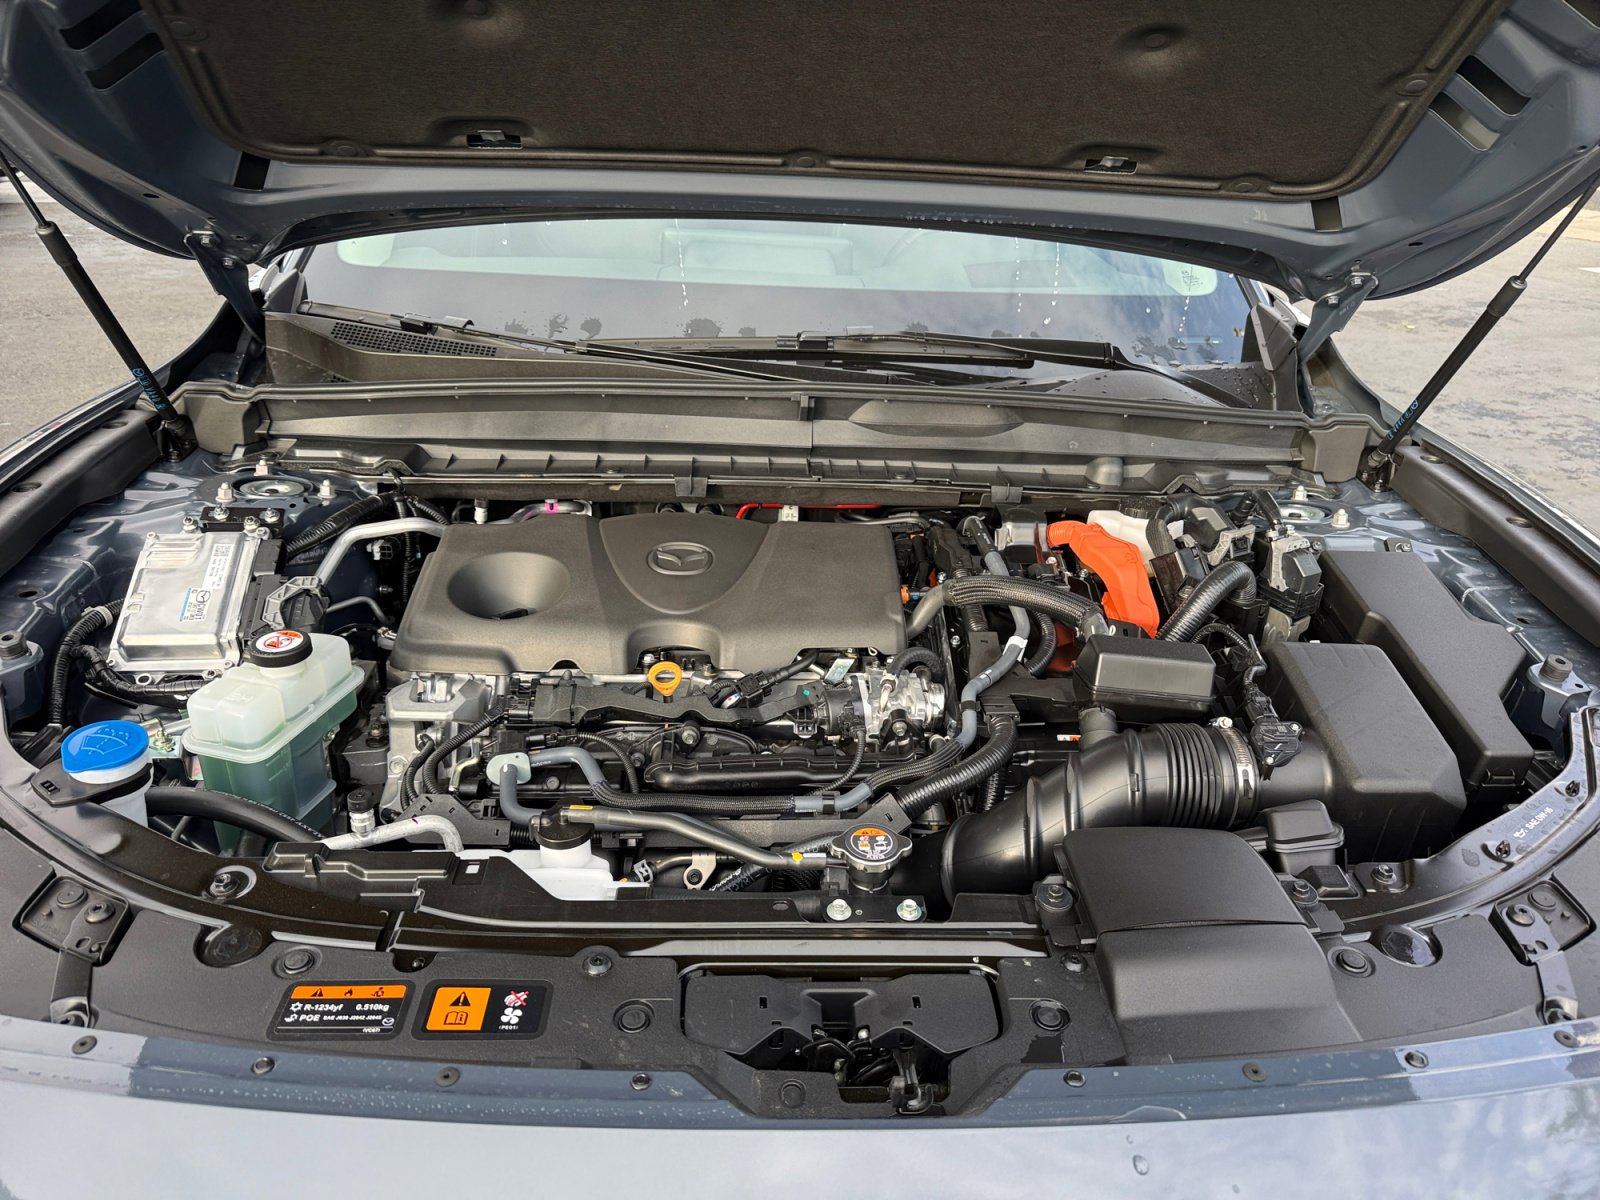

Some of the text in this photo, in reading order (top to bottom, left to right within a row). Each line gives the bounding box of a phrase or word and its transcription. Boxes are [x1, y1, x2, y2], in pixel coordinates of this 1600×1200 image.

[303, 1003, 390, 1012] R-1234yf 0.510kg
[299, 1014, 321, 1022] POE
